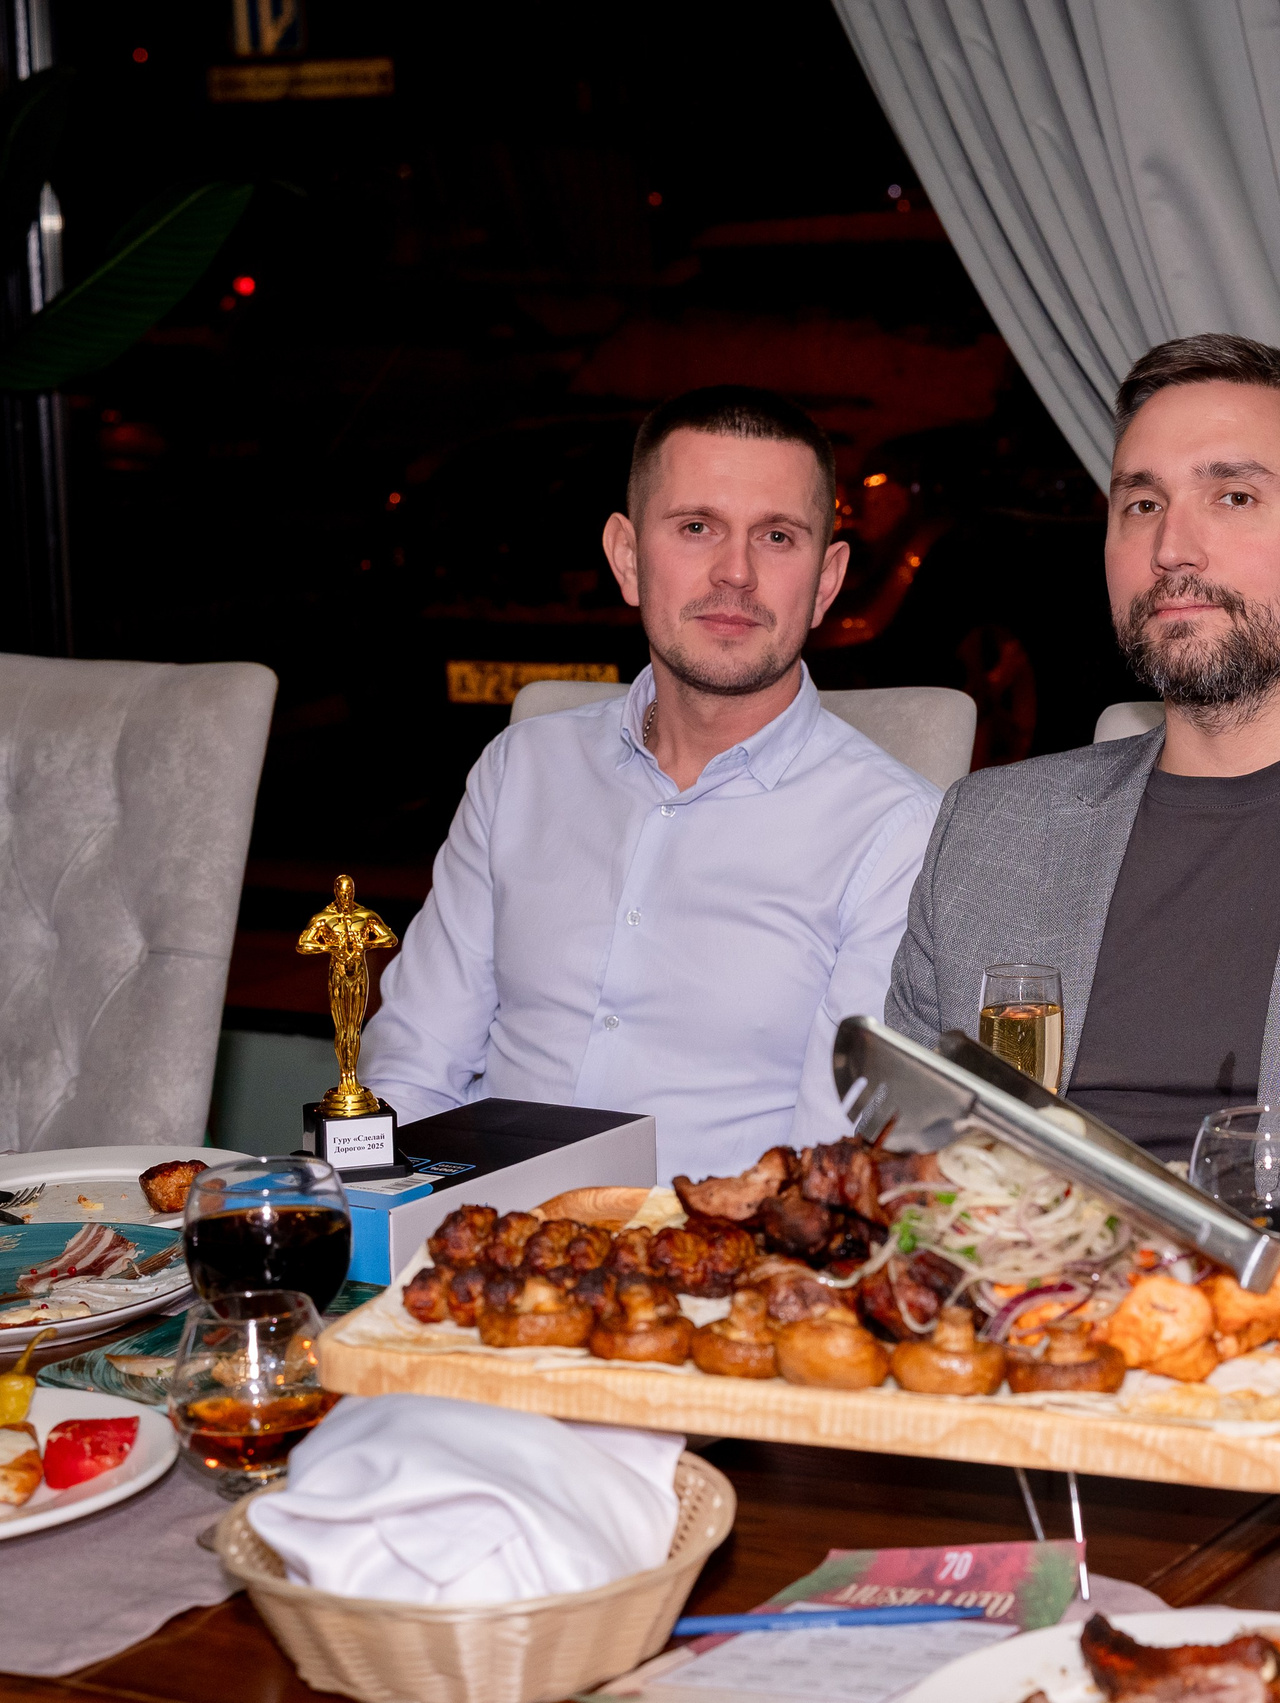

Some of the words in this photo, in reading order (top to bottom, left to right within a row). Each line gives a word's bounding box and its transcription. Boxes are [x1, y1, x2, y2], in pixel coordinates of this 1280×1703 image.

[333, 1136, 352, 1145] Гуру
[353, 1133, 385, 1142] «Сделай
[334, 1145, 366, 1154] Дорого»
[367, 1142, 385, 1150] 2025
[937, 1550, 974, 1581] 70
